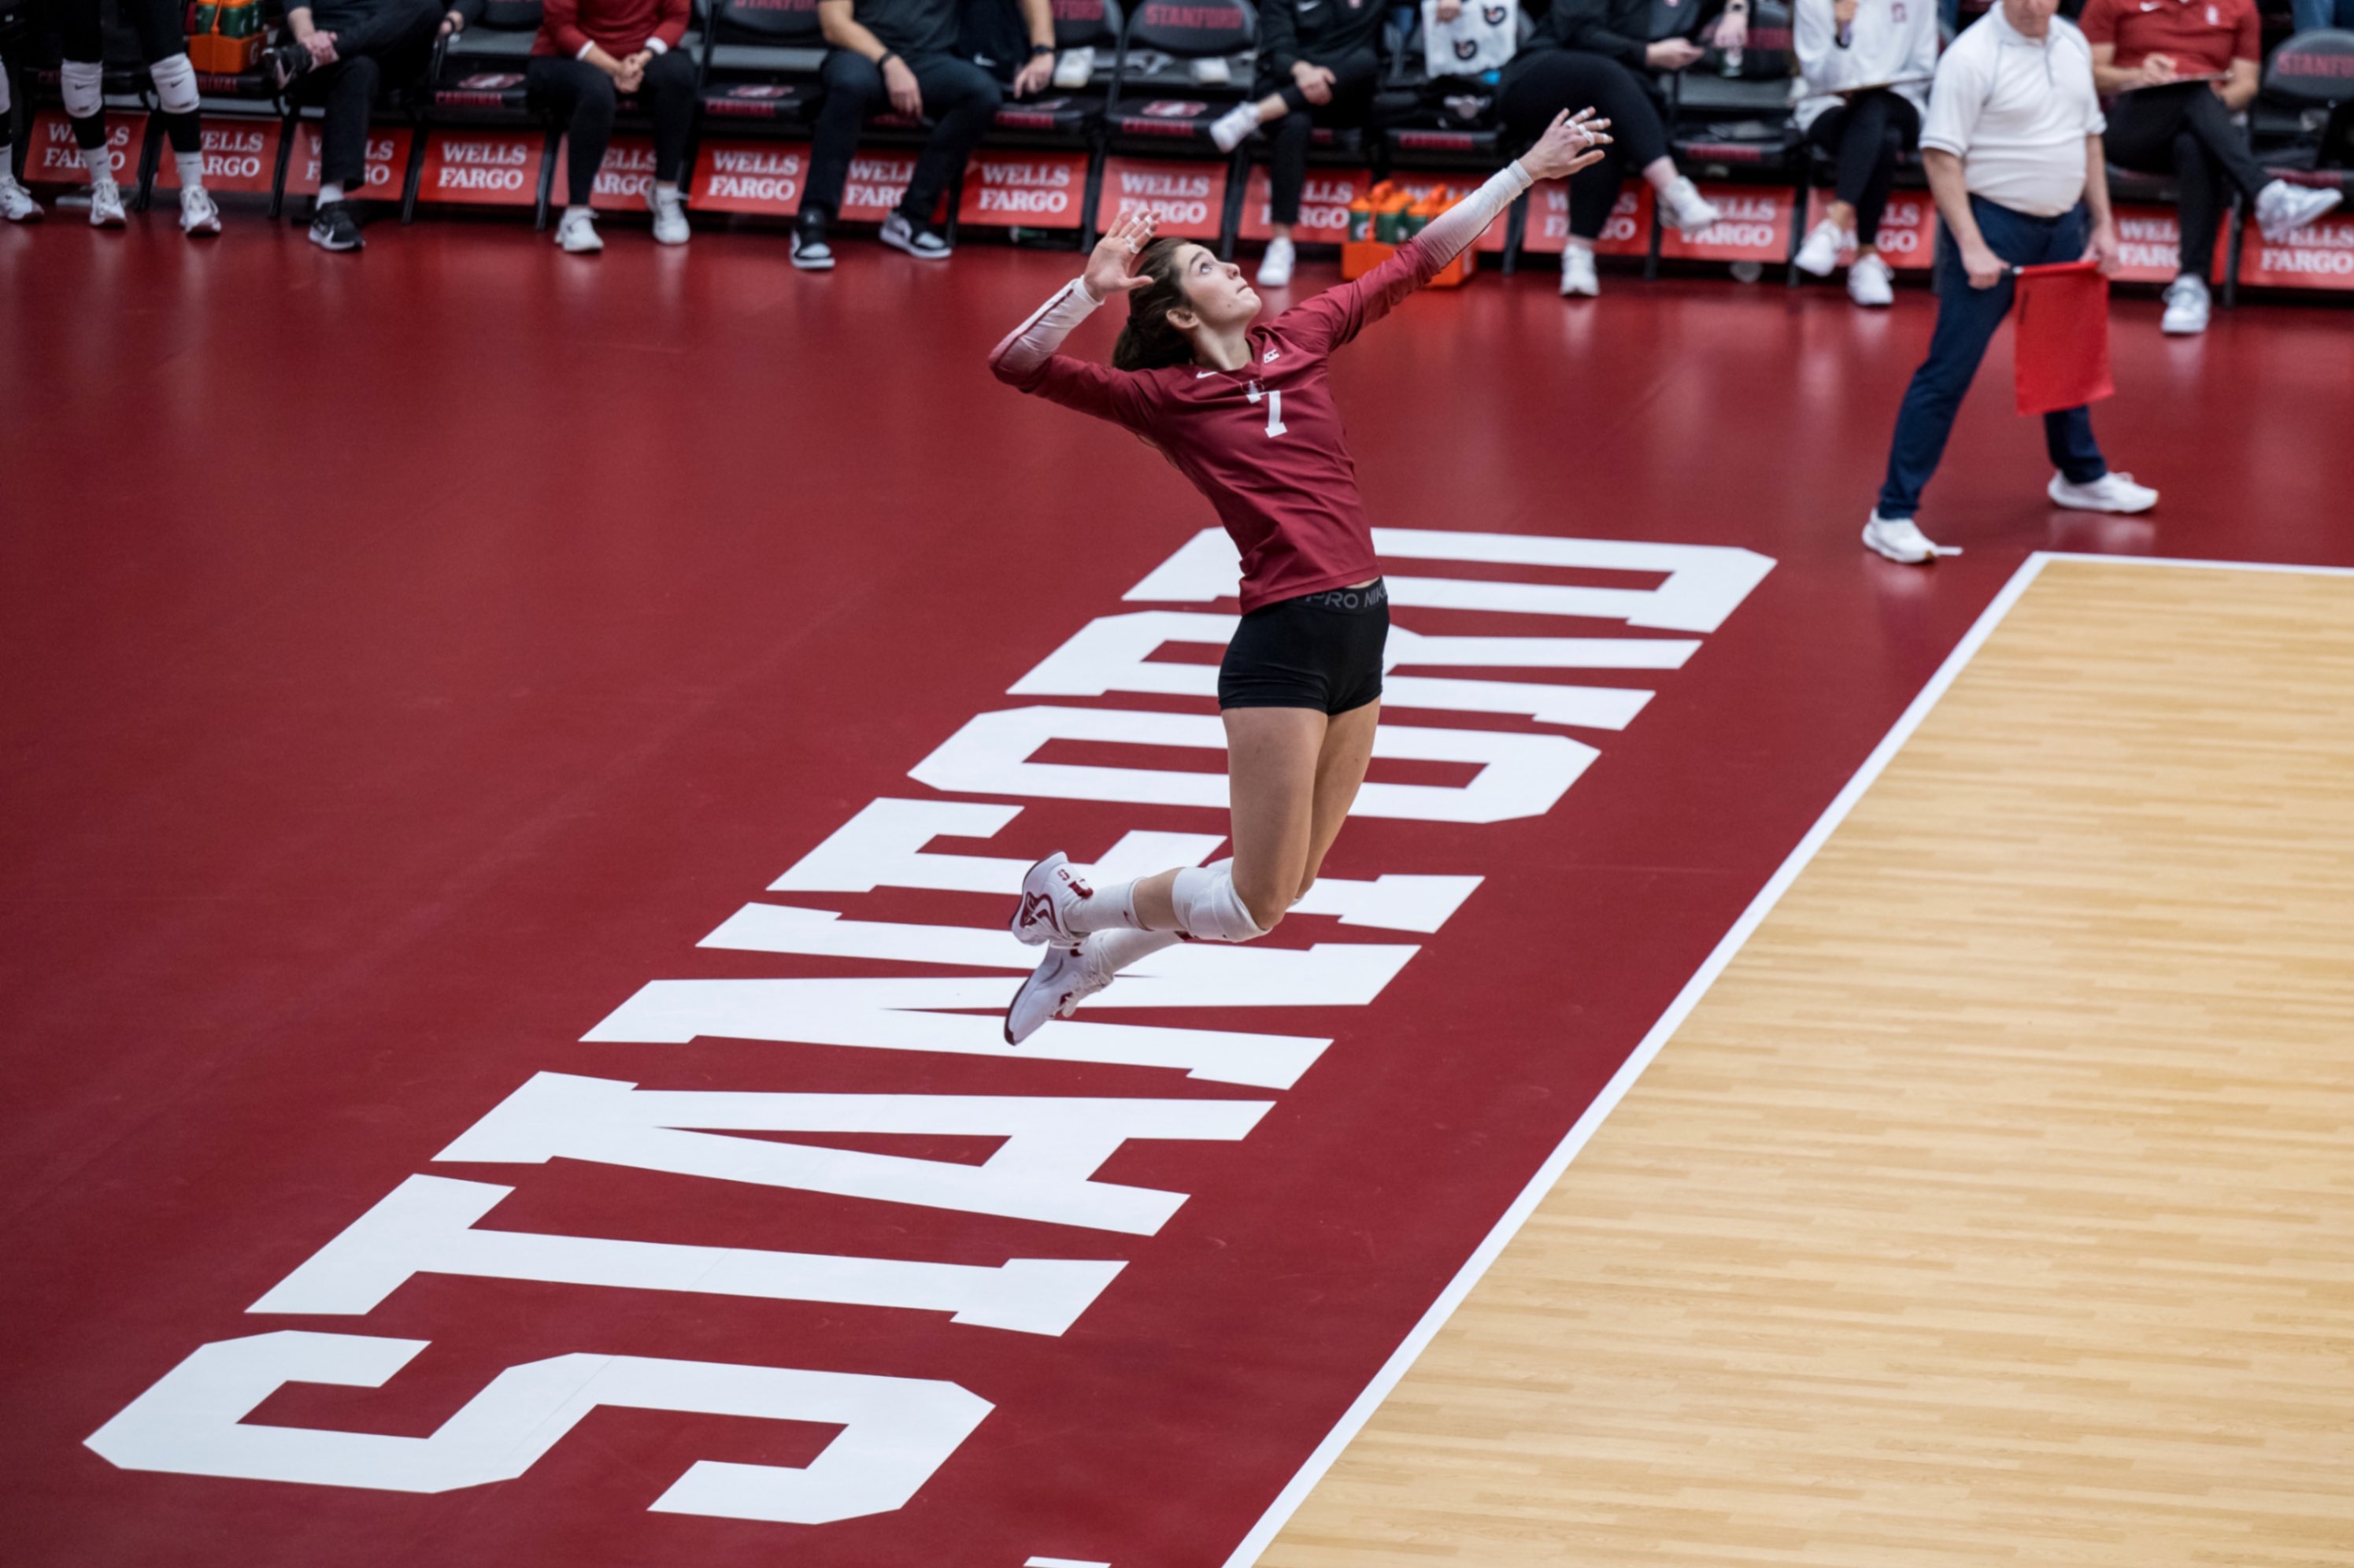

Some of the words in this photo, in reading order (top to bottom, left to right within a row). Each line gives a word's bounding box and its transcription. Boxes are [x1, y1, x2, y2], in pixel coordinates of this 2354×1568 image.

[1145, 3, 1243, 29] STANFORD
[200, 129, 264, 152] ELLS
[442, 142, 527, 165] WELLS
[601, 147, 657, 171] ELLS
[712, 150, 799, 176] WELLS
[202, 156, 261, 177] ARGO
[438, 167, 524, 190] FARGO
[983, 162, 1070, 187] WELLS
[593, 172, 657, 195] ARGO
[708, 175, 796, 201] FARGO
[1120, 171, 1210, 198] WELLS
[979, 188, 1068, 213] FARGO
[1119, 197, 1208, 224] FARGO
[1712, 197, 1777, 222] ELLS
[2260, 249, 2353, 274] FARGO
[1364, 582, 1388, 608] NIK
[83, 526, 1777, 1525] STANFORD
